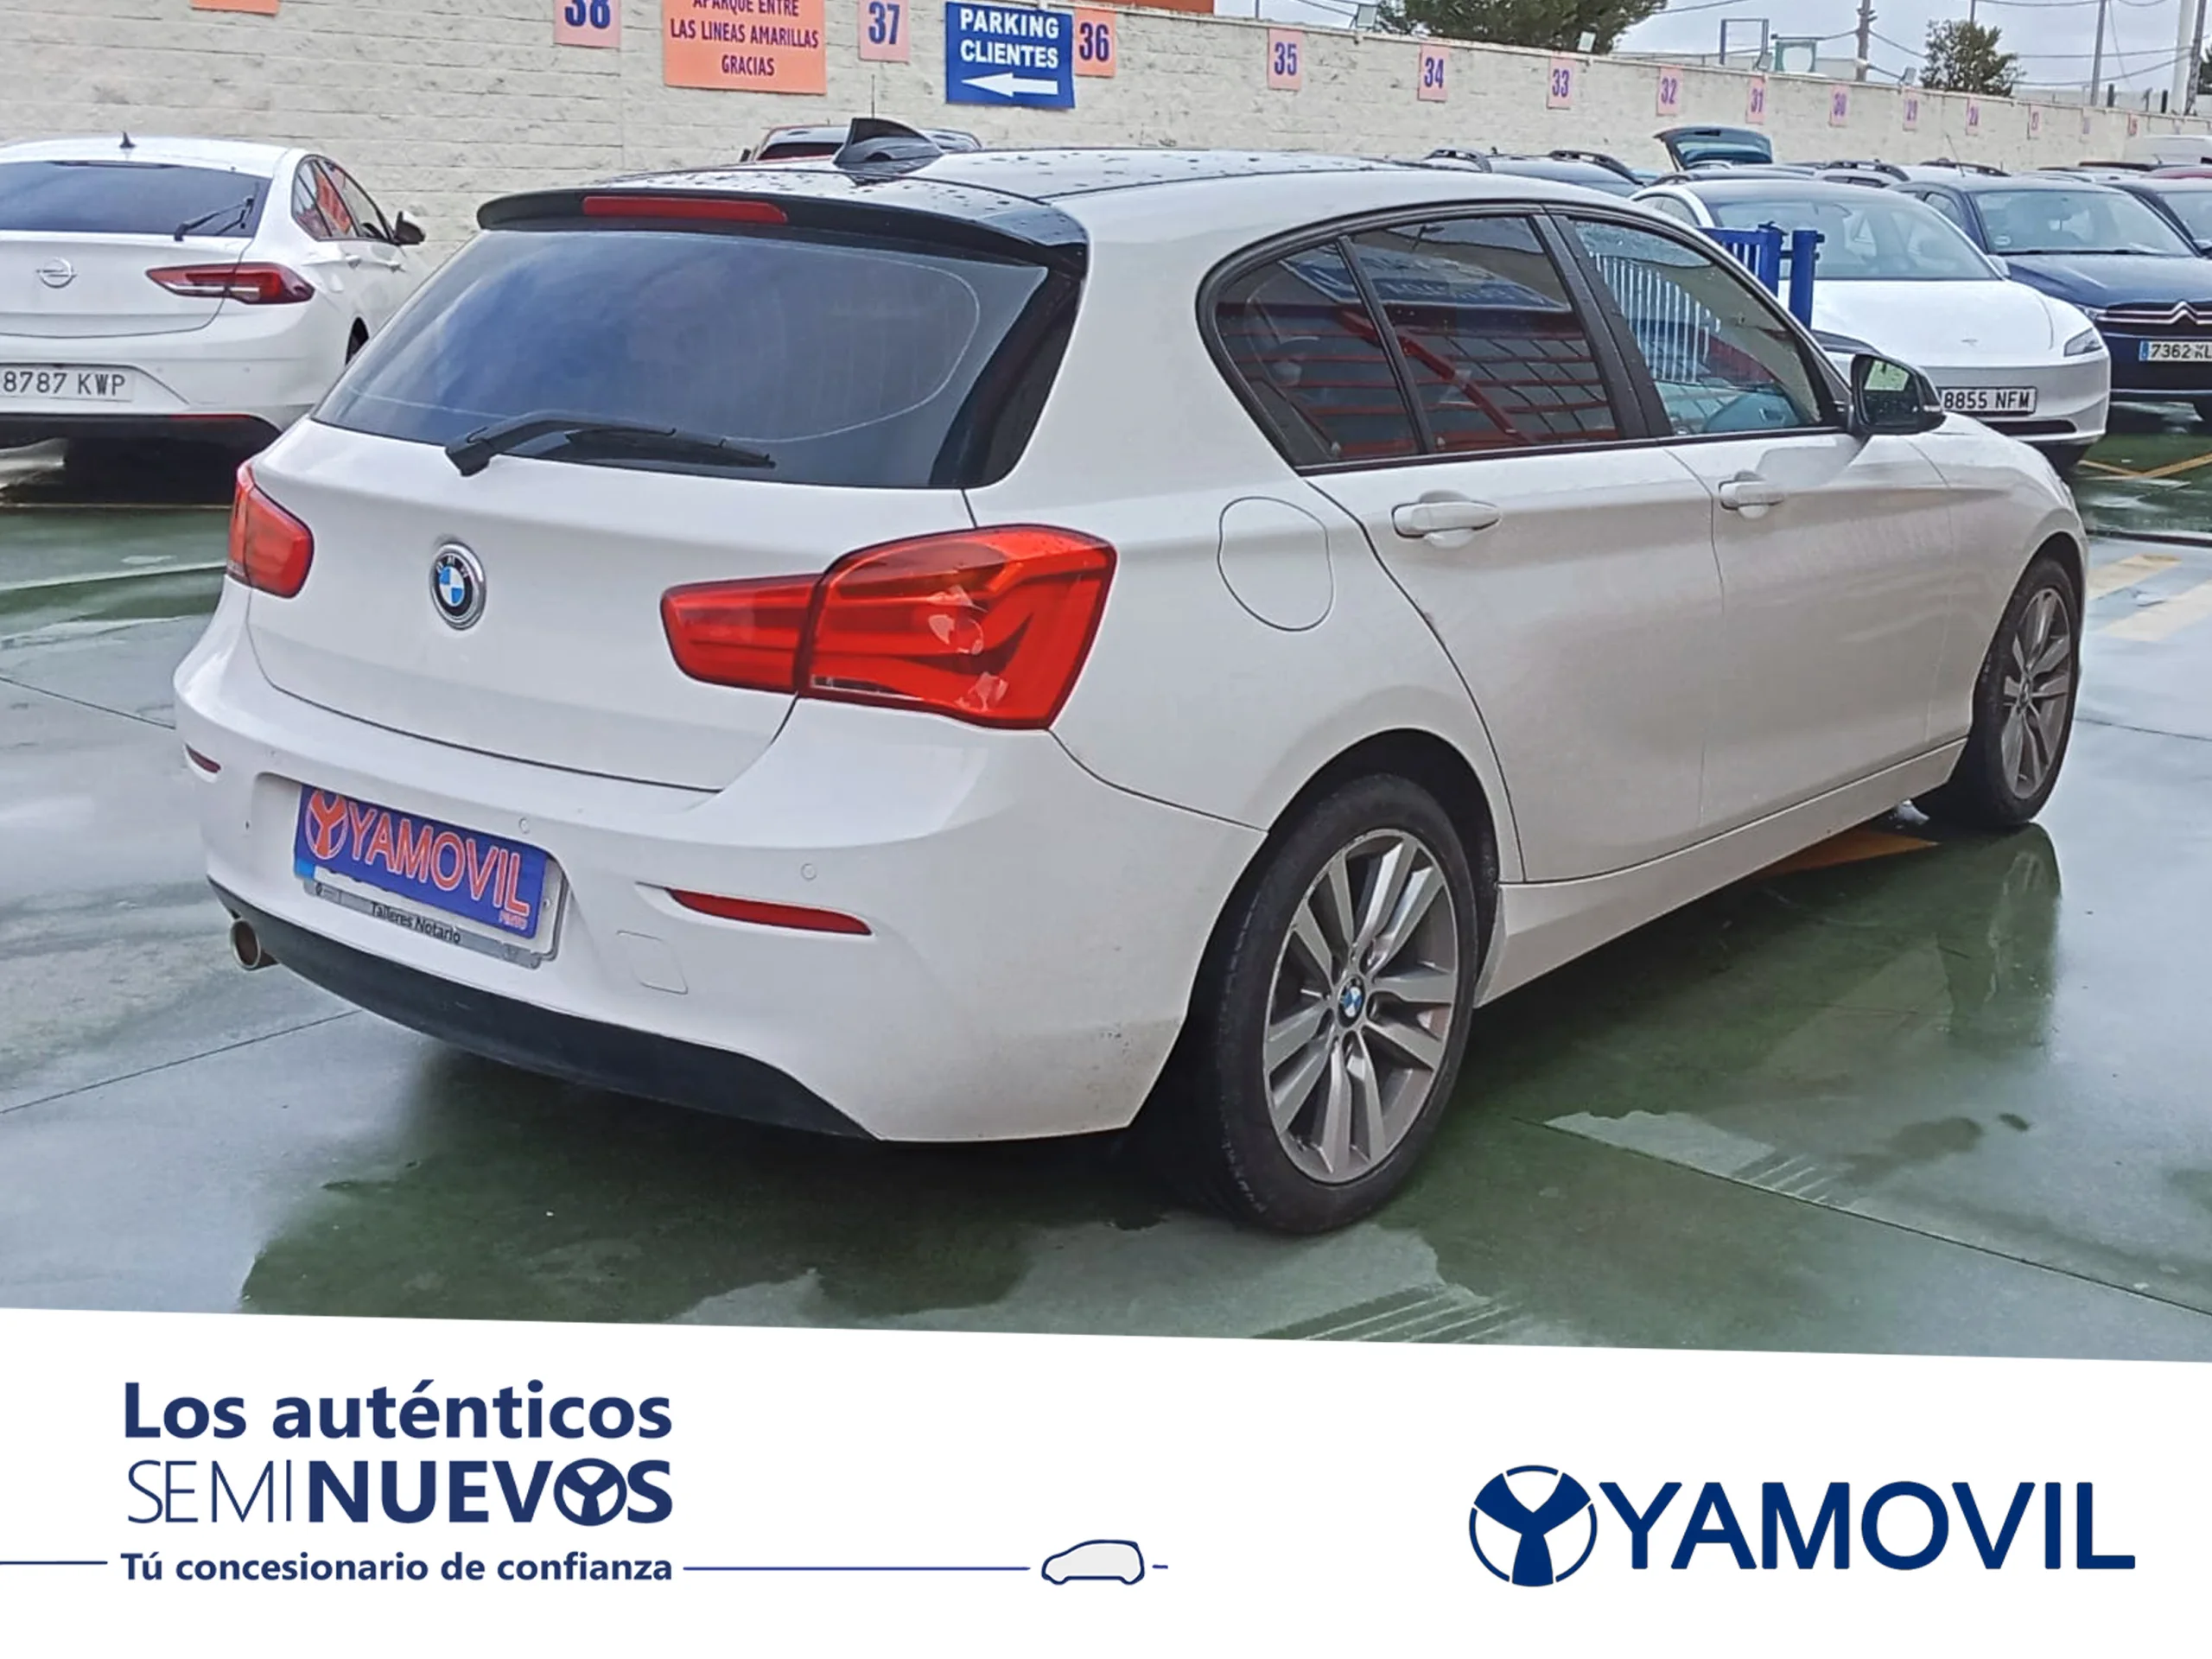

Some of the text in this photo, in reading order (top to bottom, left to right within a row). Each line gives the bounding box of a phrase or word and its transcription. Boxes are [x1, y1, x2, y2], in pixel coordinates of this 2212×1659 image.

[759, 0, 799, 16] ENTRE
[868, 1, 900, 45] 37
[960, 8, 1059, 39] PARKING
[671, 18, 818, 49] LAS LINEAS AMARILLAS
[1079, 22, 1110, 62] 36
[721, 54, 775, 77] GRACIAS
[960, 39, 1059, 69] CLIENTES
[1274, 41, 1298, 77] 35
[1424, 57, 1445, 89] 34
[1552, 68, 1570, 99] 33
[1661, 76, 1678, 105] 32
[2151, 343, 2191, 359] 7362
[3, 371, 126, 396] 8787 KWP
[1944, 391, 2030, 410] 8855 NFM
[347, 801, 530, 917] YAMOVIL
[372, 901, 461, 944] Talleres Notario
